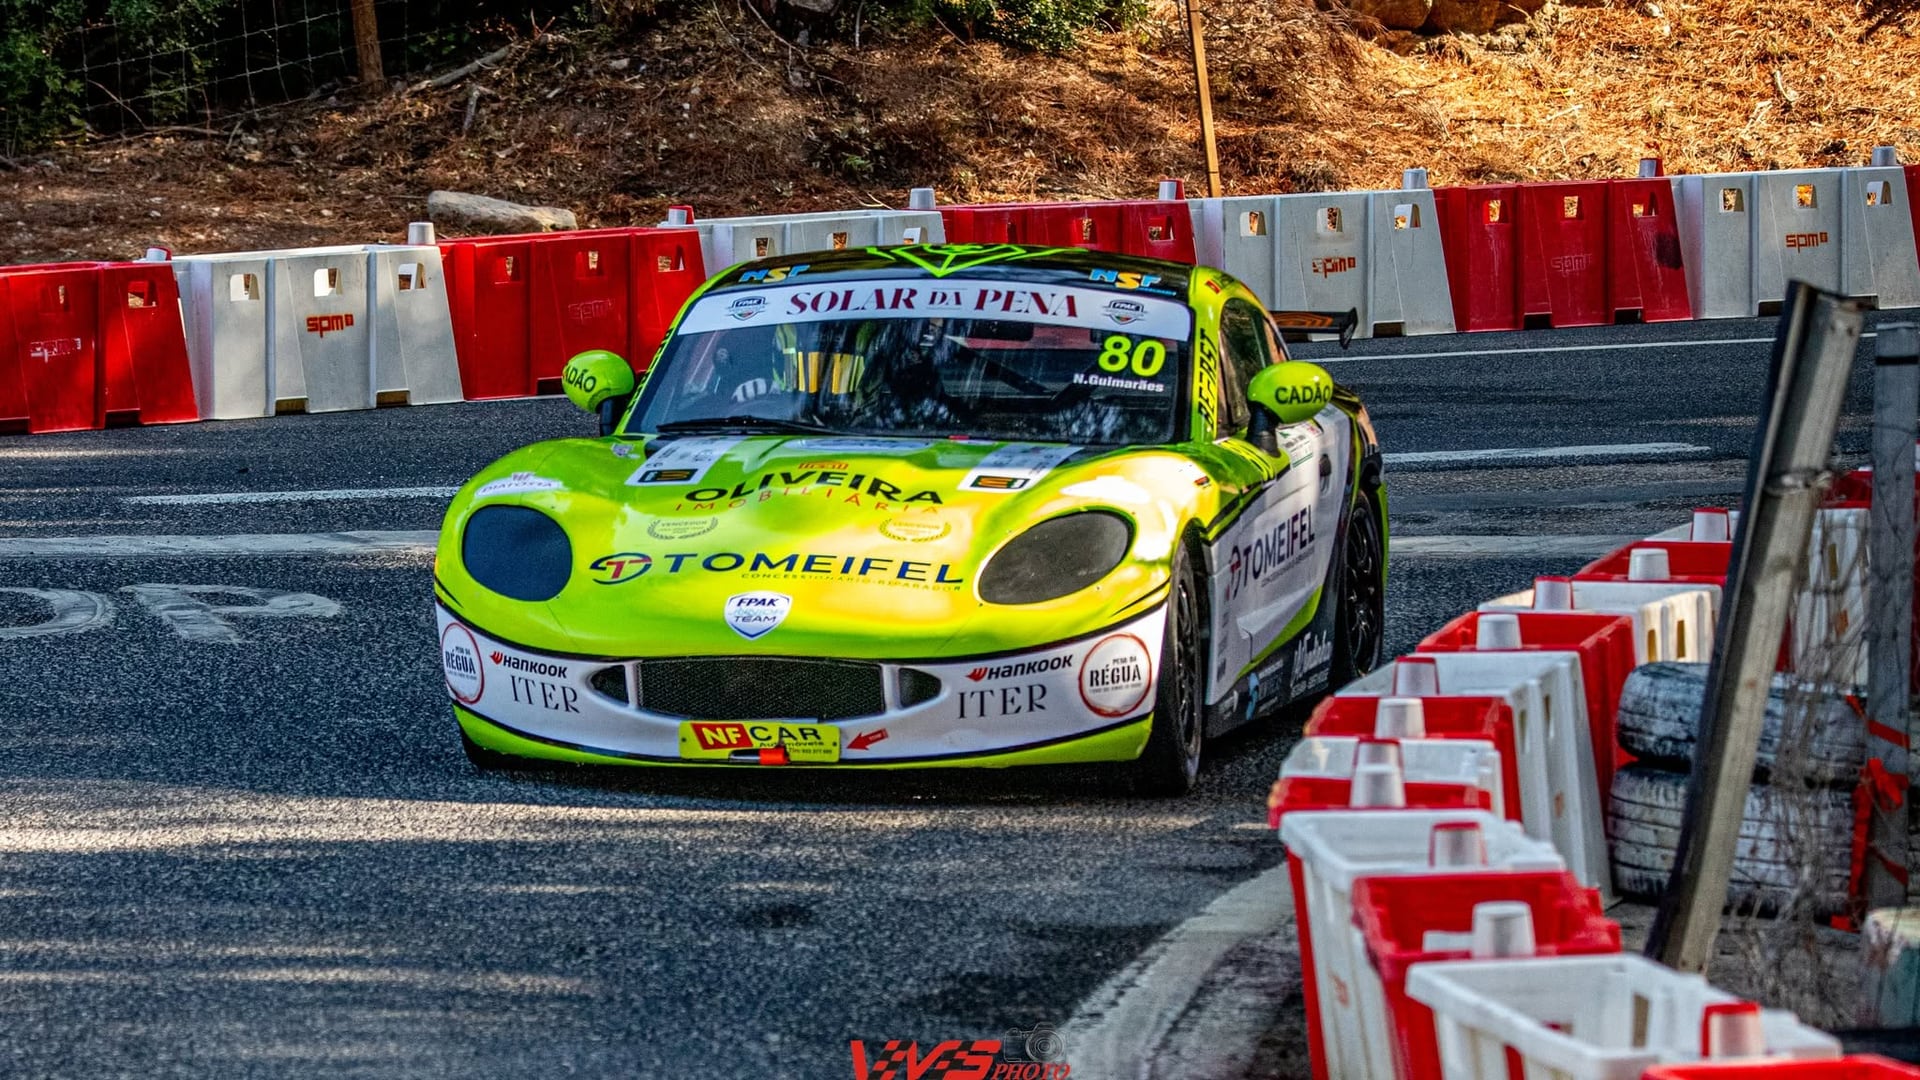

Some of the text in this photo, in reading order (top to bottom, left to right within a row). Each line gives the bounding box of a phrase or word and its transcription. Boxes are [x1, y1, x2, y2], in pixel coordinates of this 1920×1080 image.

[1089, 268, 1161, 290] NSF
[786, 288, 1079, 318] SOLAR DA PENA
[1098, 334, 1166, 377] 80
[564, 365, 597, 393] ADÃO
[1073, 373, 1165, 392] N.Guimarães
[1274, 381, 1331, 405] CADÃO
[685, 471, 944, 504] OLIVEIRA
[1243, 504, 1315, 587] TOMEIFEL
[663, 552, 964, 584] TOMEIFEL
[736, 597, 780, 607] FPAK
[734, 615, 777, 623] TEAM
[445, 648, 477, 675] RÉGUA
[1089, 663, 1142, 688] RÉGUA
[510, 674, 581, 714] ITER
[957, 683, 1048, 719] ITER
[700, 726, 822, 745] NF CAR
